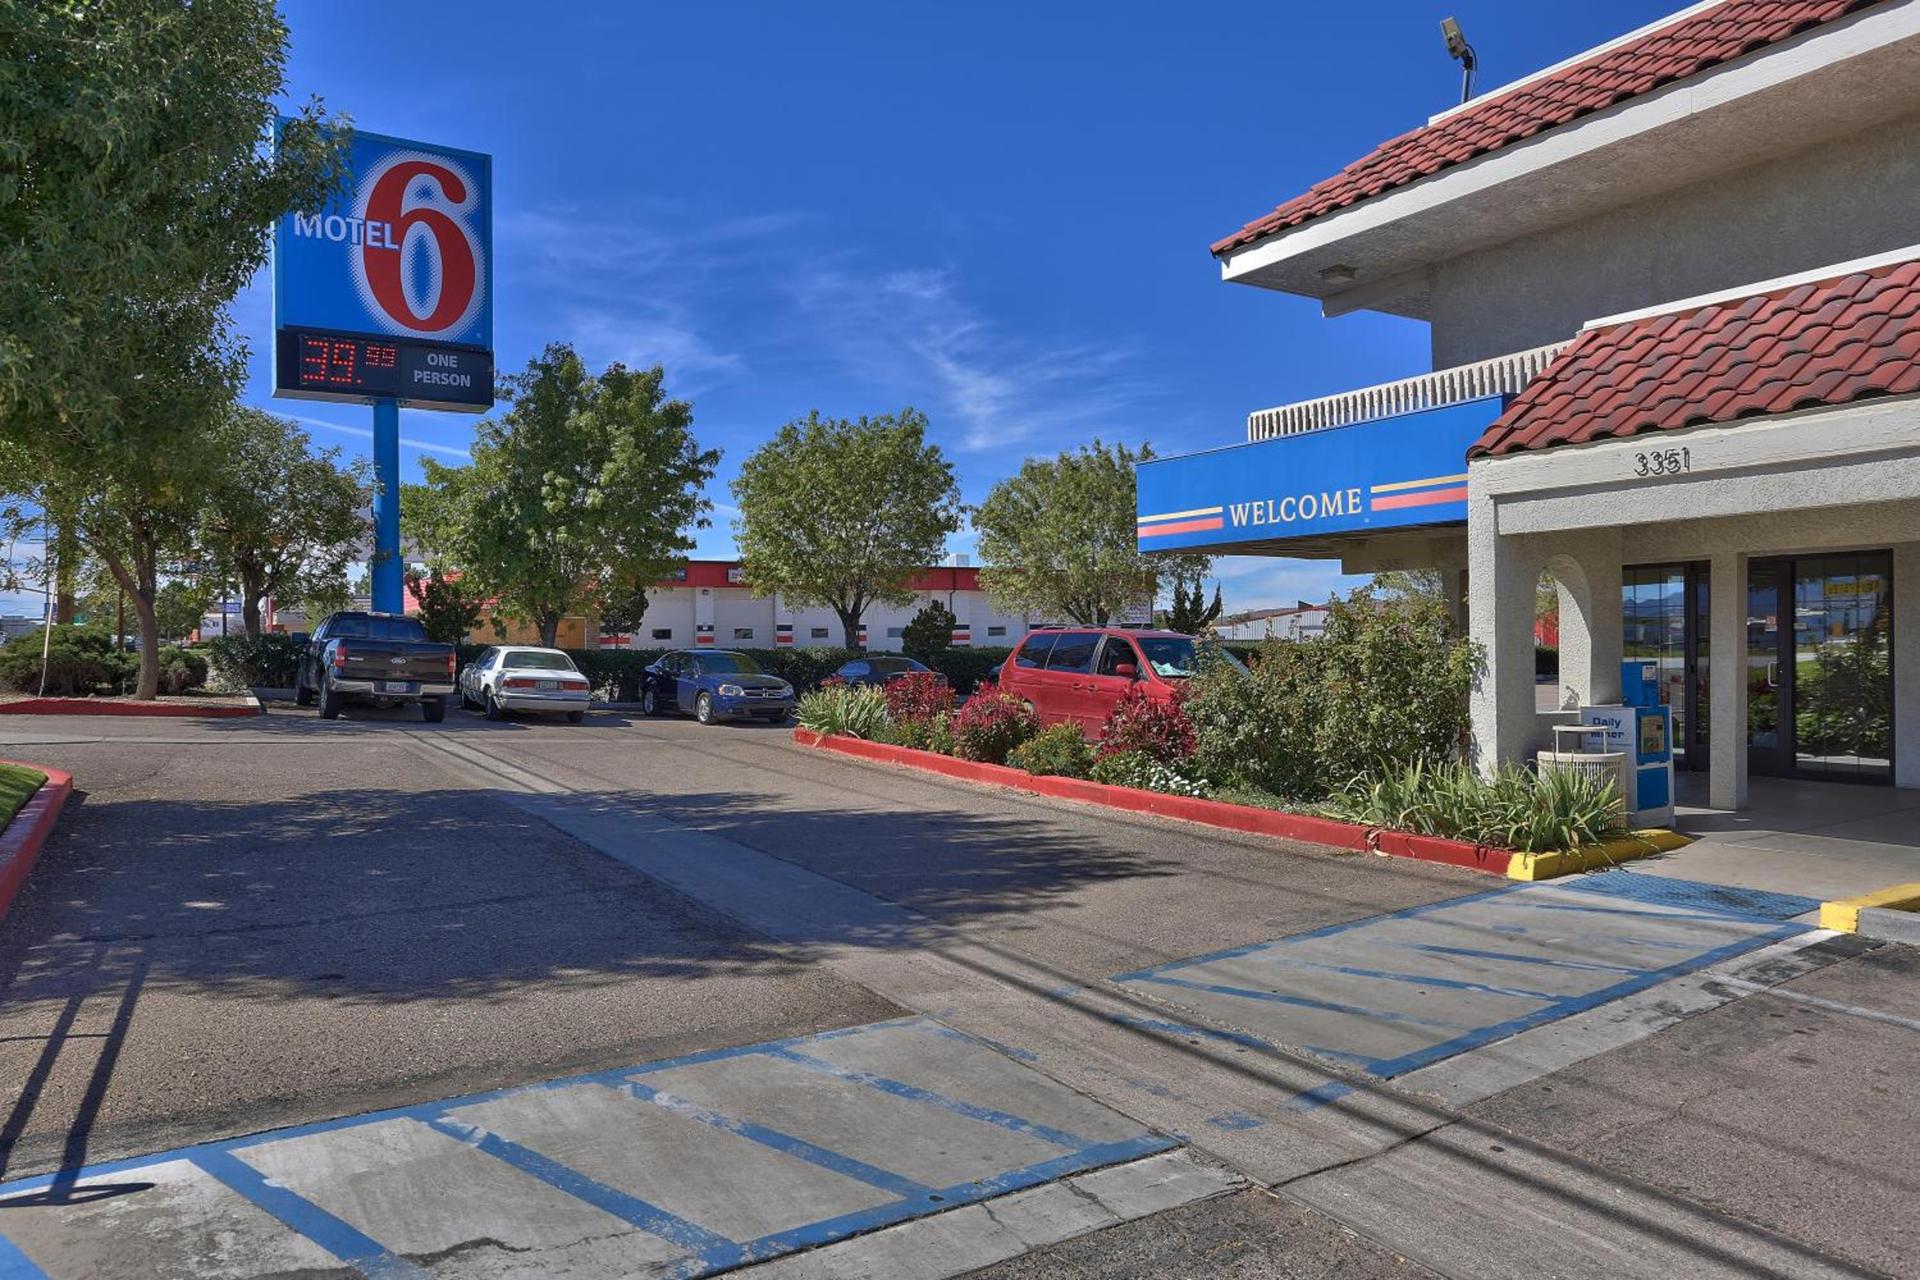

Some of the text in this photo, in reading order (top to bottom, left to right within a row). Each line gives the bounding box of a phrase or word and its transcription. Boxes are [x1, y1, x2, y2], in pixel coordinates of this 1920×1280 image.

[293, 161, 475, 332] MOTEL 6
[427, 353, 458, 368] ONE
[413, 371, 471, 388] PERSON
[1634, 446, 1690, 476] 3351
[1229, 488, 1362, 527] WELCOME
